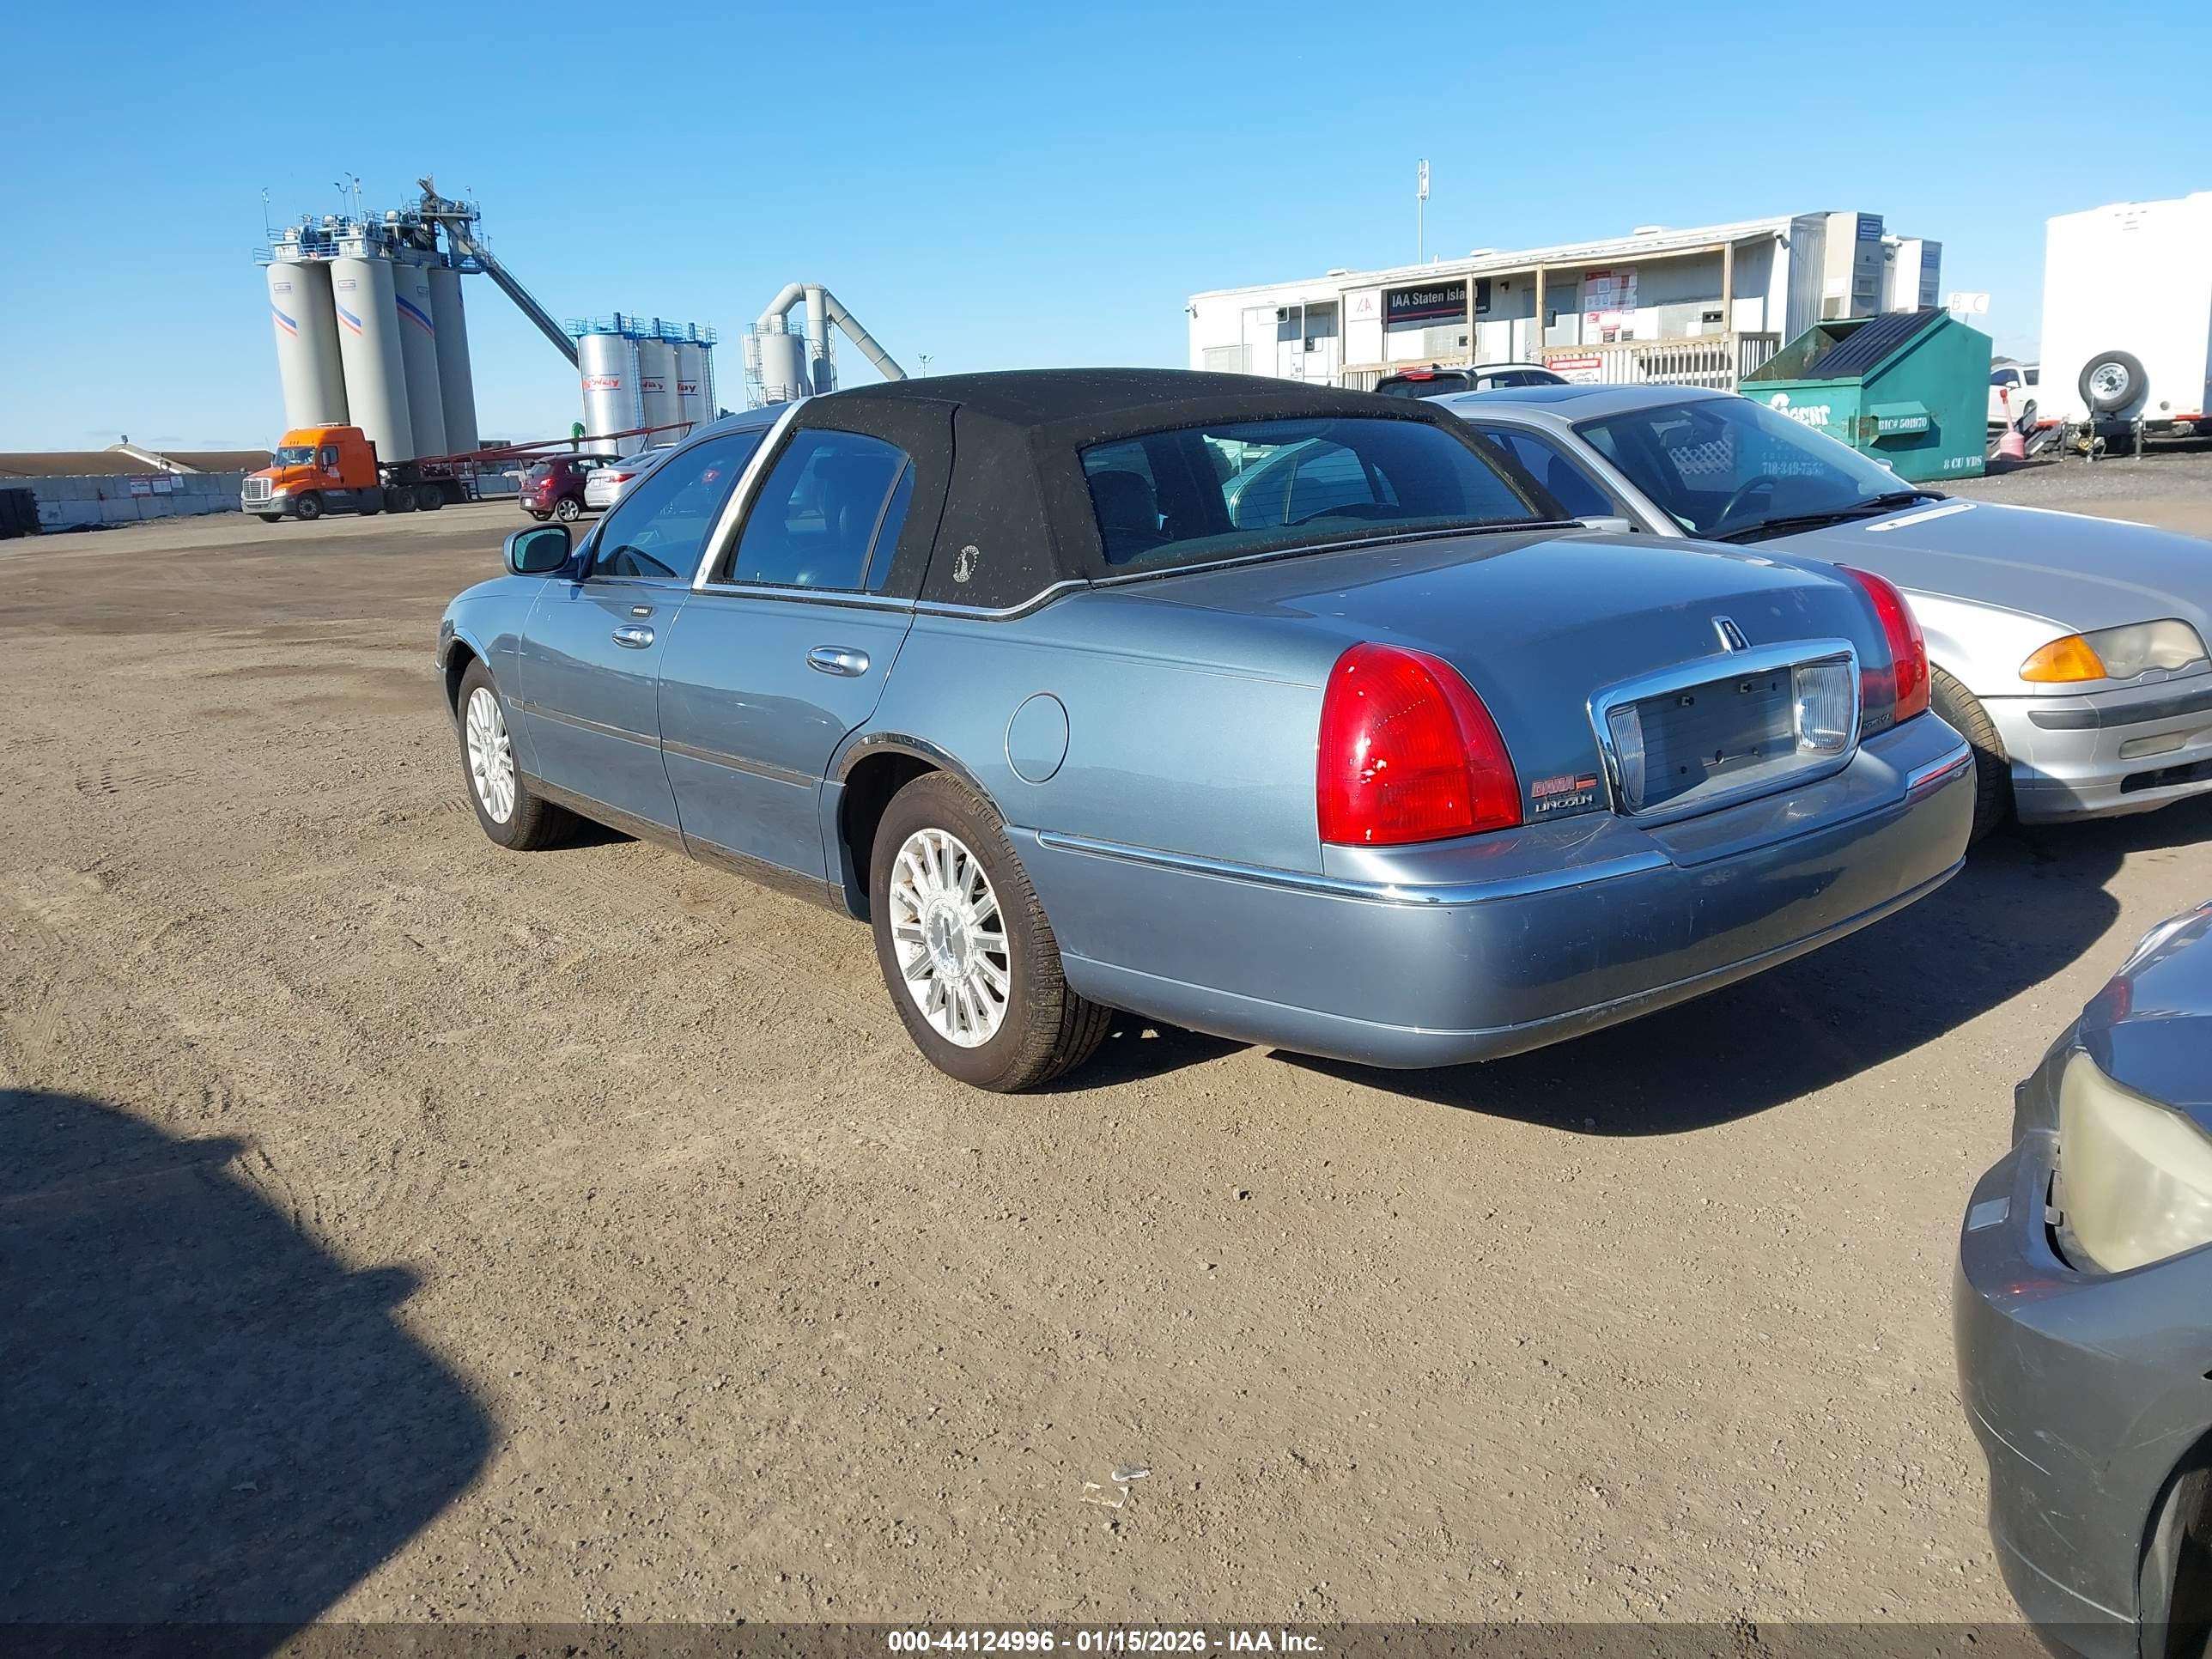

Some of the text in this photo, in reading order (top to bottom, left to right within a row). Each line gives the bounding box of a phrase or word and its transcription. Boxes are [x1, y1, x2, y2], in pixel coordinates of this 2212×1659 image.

[1392, 294, 1411, 308] IAA
[1413, 289, 1444, 306] Staten
[1952, 295, 1960, 310] B
[1943, 455, 1983, 470] 8 CU YDS
[1532, 775, 1576, 798] DANA
[1535, 794, 1593, 812] LINCOLN
